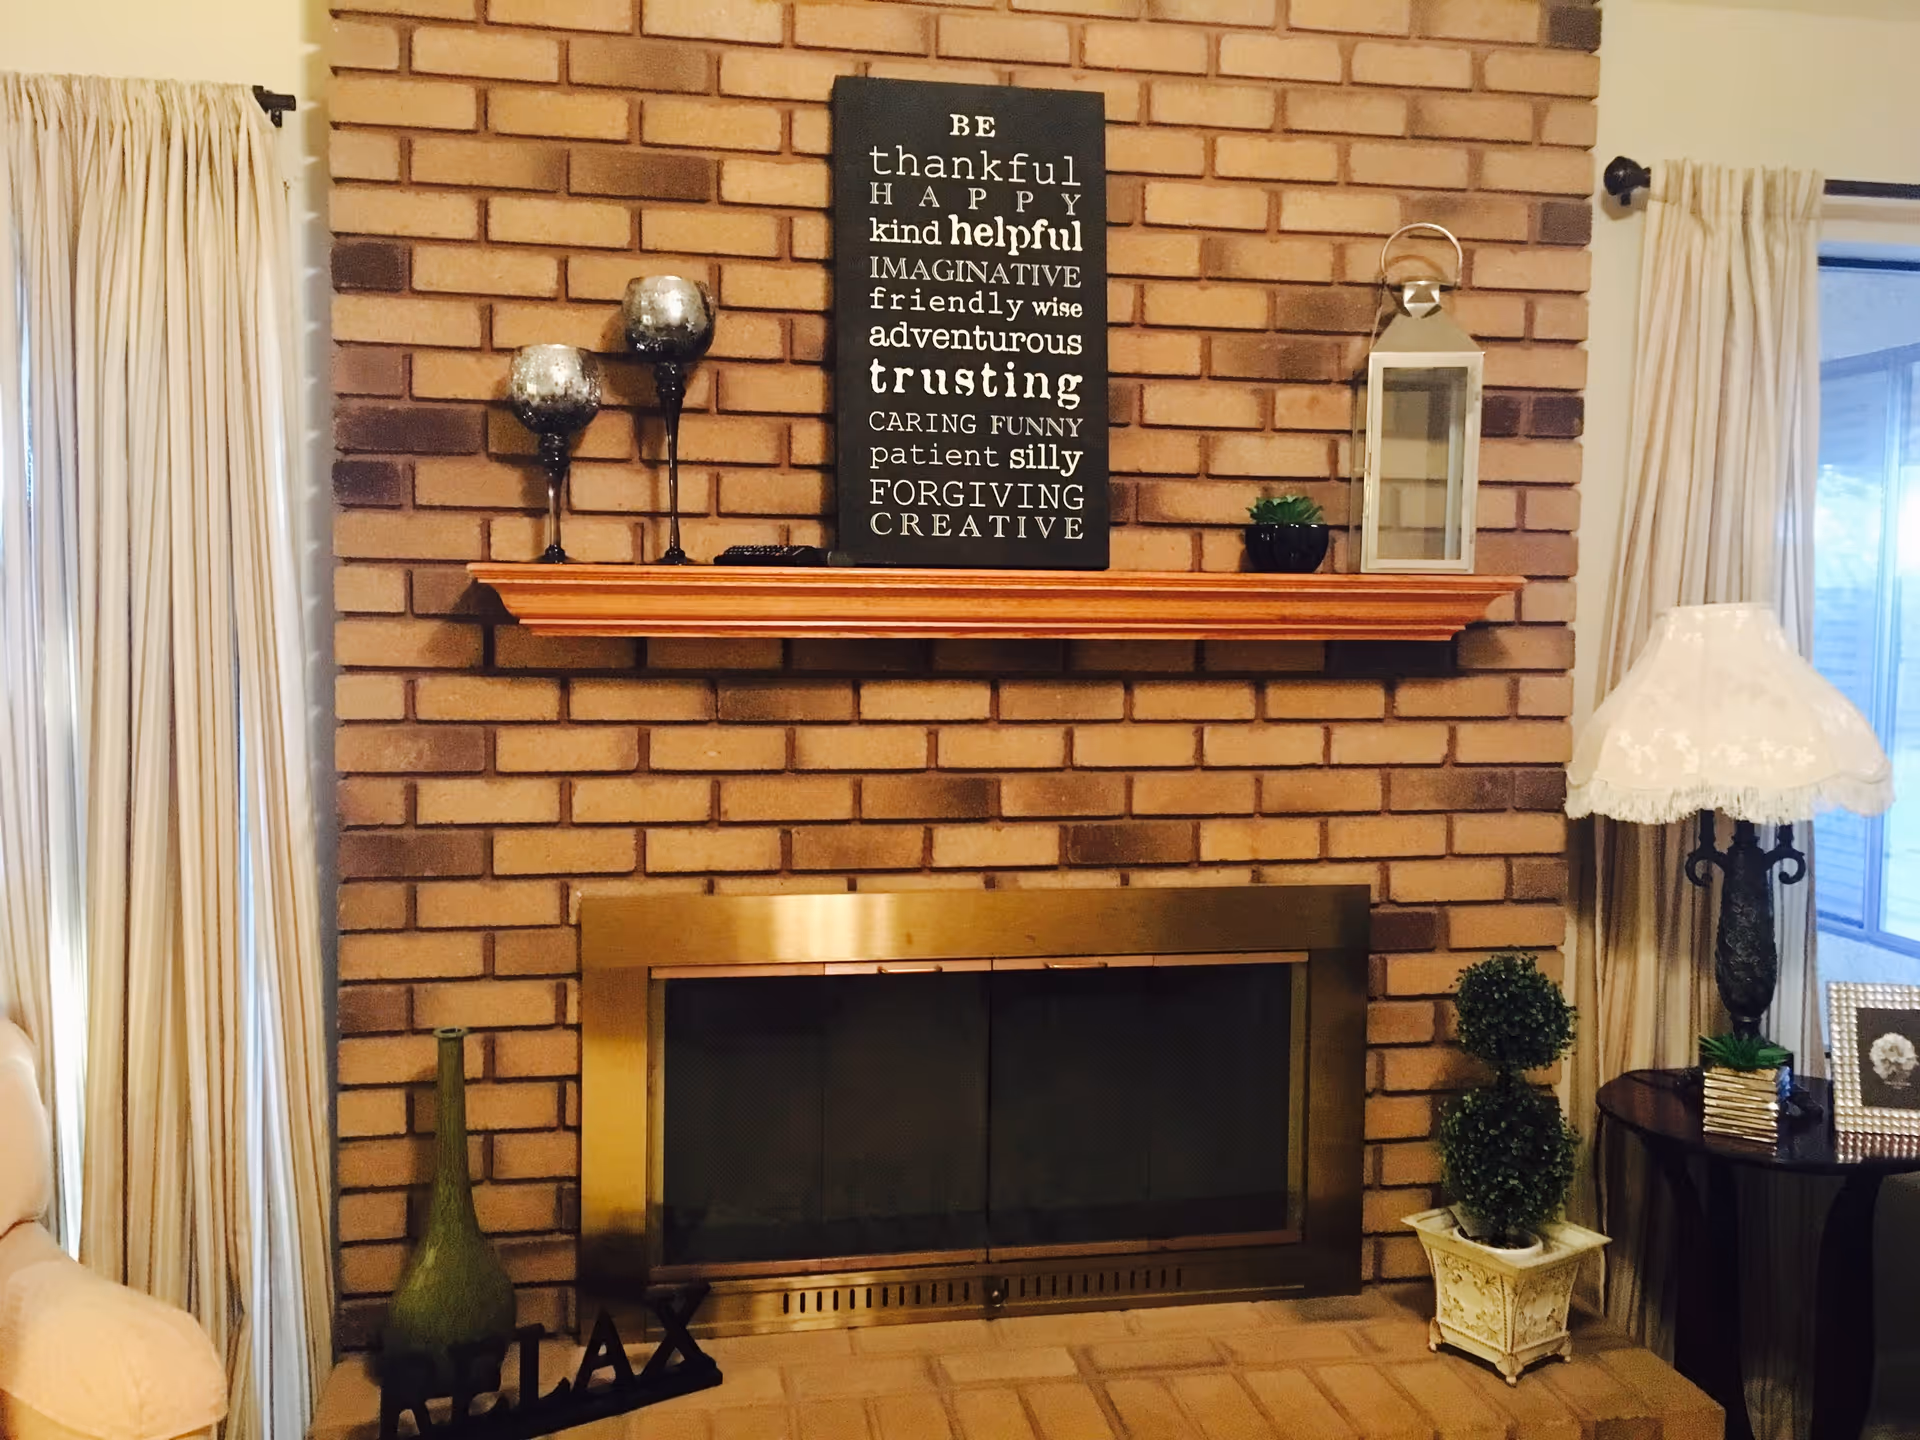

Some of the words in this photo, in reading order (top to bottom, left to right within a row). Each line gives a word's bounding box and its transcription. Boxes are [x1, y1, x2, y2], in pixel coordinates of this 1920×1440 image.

[950, 114, 996, 137] BE
[869, 145, 1082, 187] thankful
[869, 217, 942, 245] kind
[948, 214, 1083, 256] helpful
[869, 256, 1082, 288] IMAGINATIVE
[869, 286, 1024, 321] friendly
[1032, 297, 1083, 318] wise
[869, 321, 1083, 355] adventurous
[869, 358, 1083, 410] trusting
[869, 411, 977, 434] CARING
[990, 415, 1084, 437] FUNNY
[869, 443, 1000, 469] patient
[1009, 444, 1084, 477] silly
[869, 479, 1085, 510] FORGIVING
[870, 512, 1084, 539] CREATIVE
